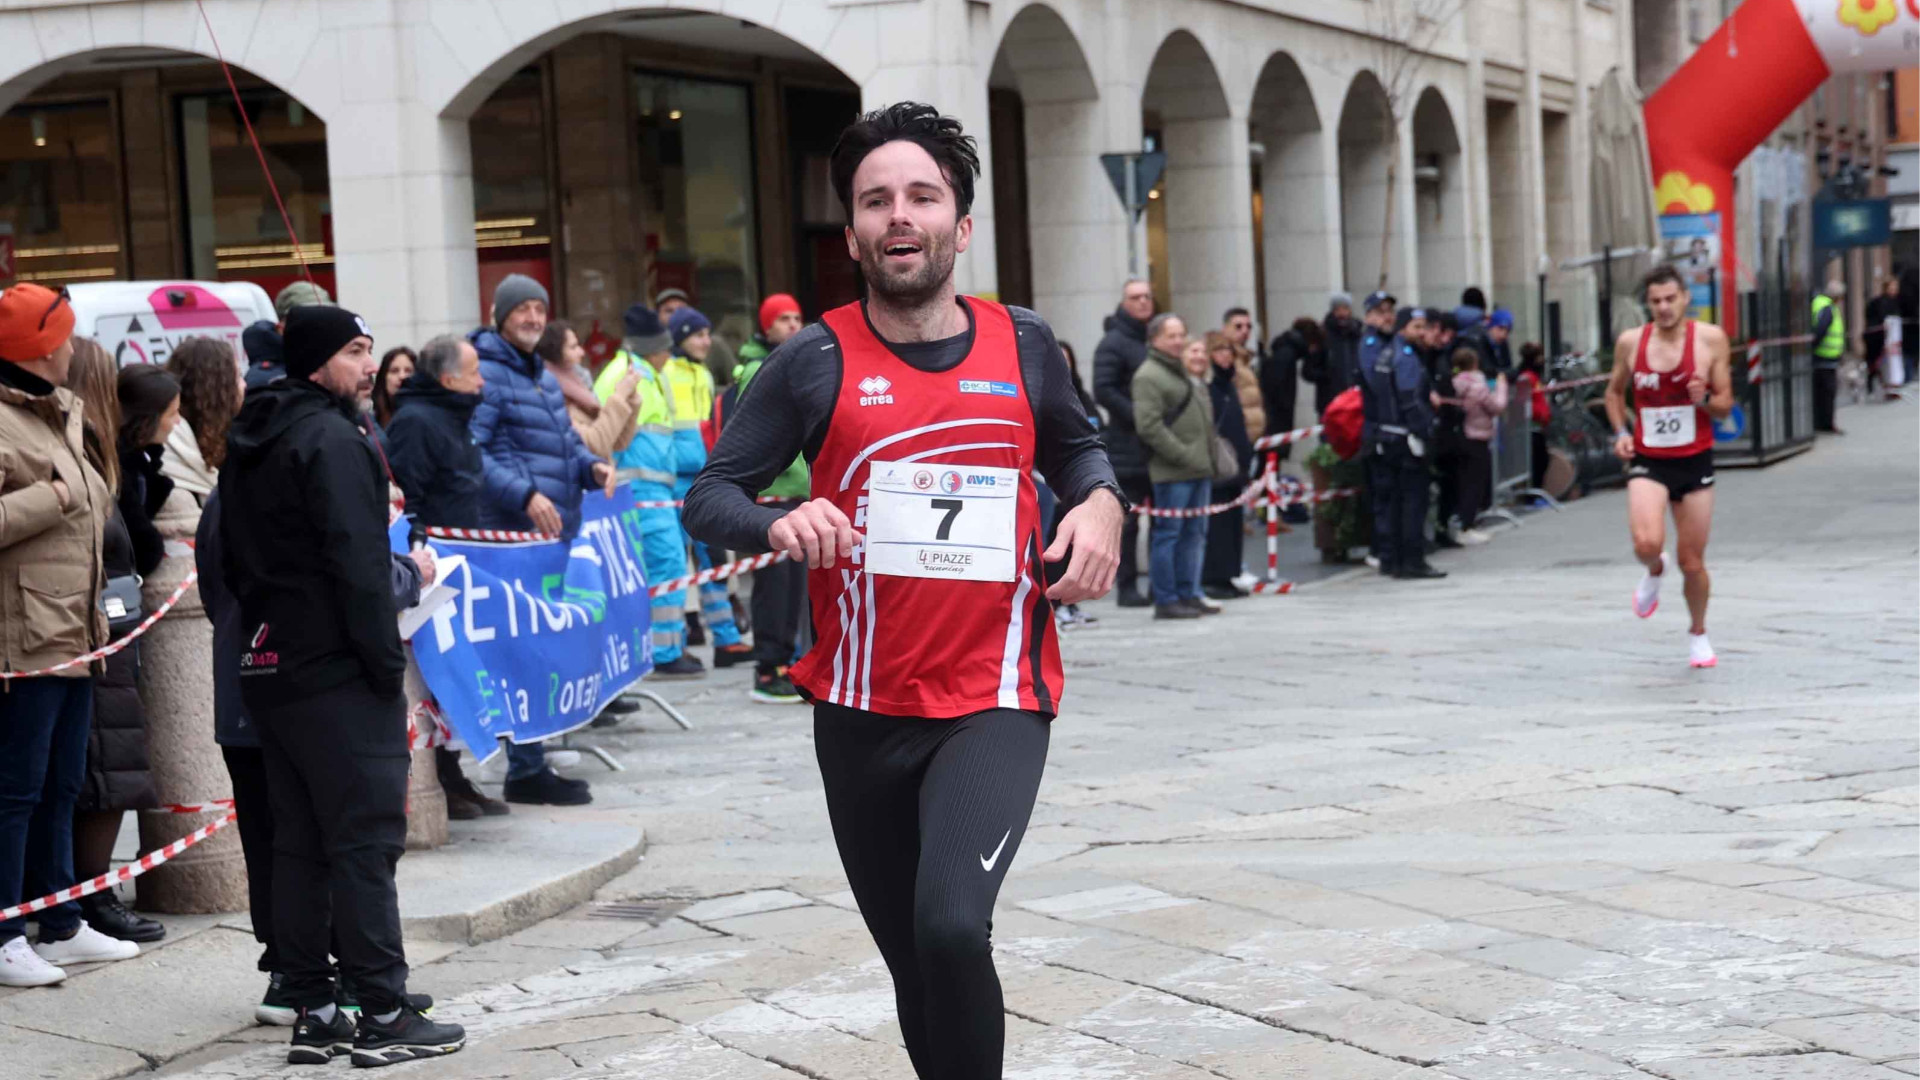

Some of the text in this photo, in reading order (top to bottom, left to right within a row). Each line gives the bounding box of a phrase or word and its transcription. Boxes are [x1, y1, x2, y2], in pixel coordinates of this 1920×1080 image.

[859, 395, 894, 407] errea
[1655, 419, 1681, 434] 20
[966, 475, 996, 486] AVIS
[931, 498, 963, 541] 7
[919, 549, 972, 565] 4 PIAZZE
